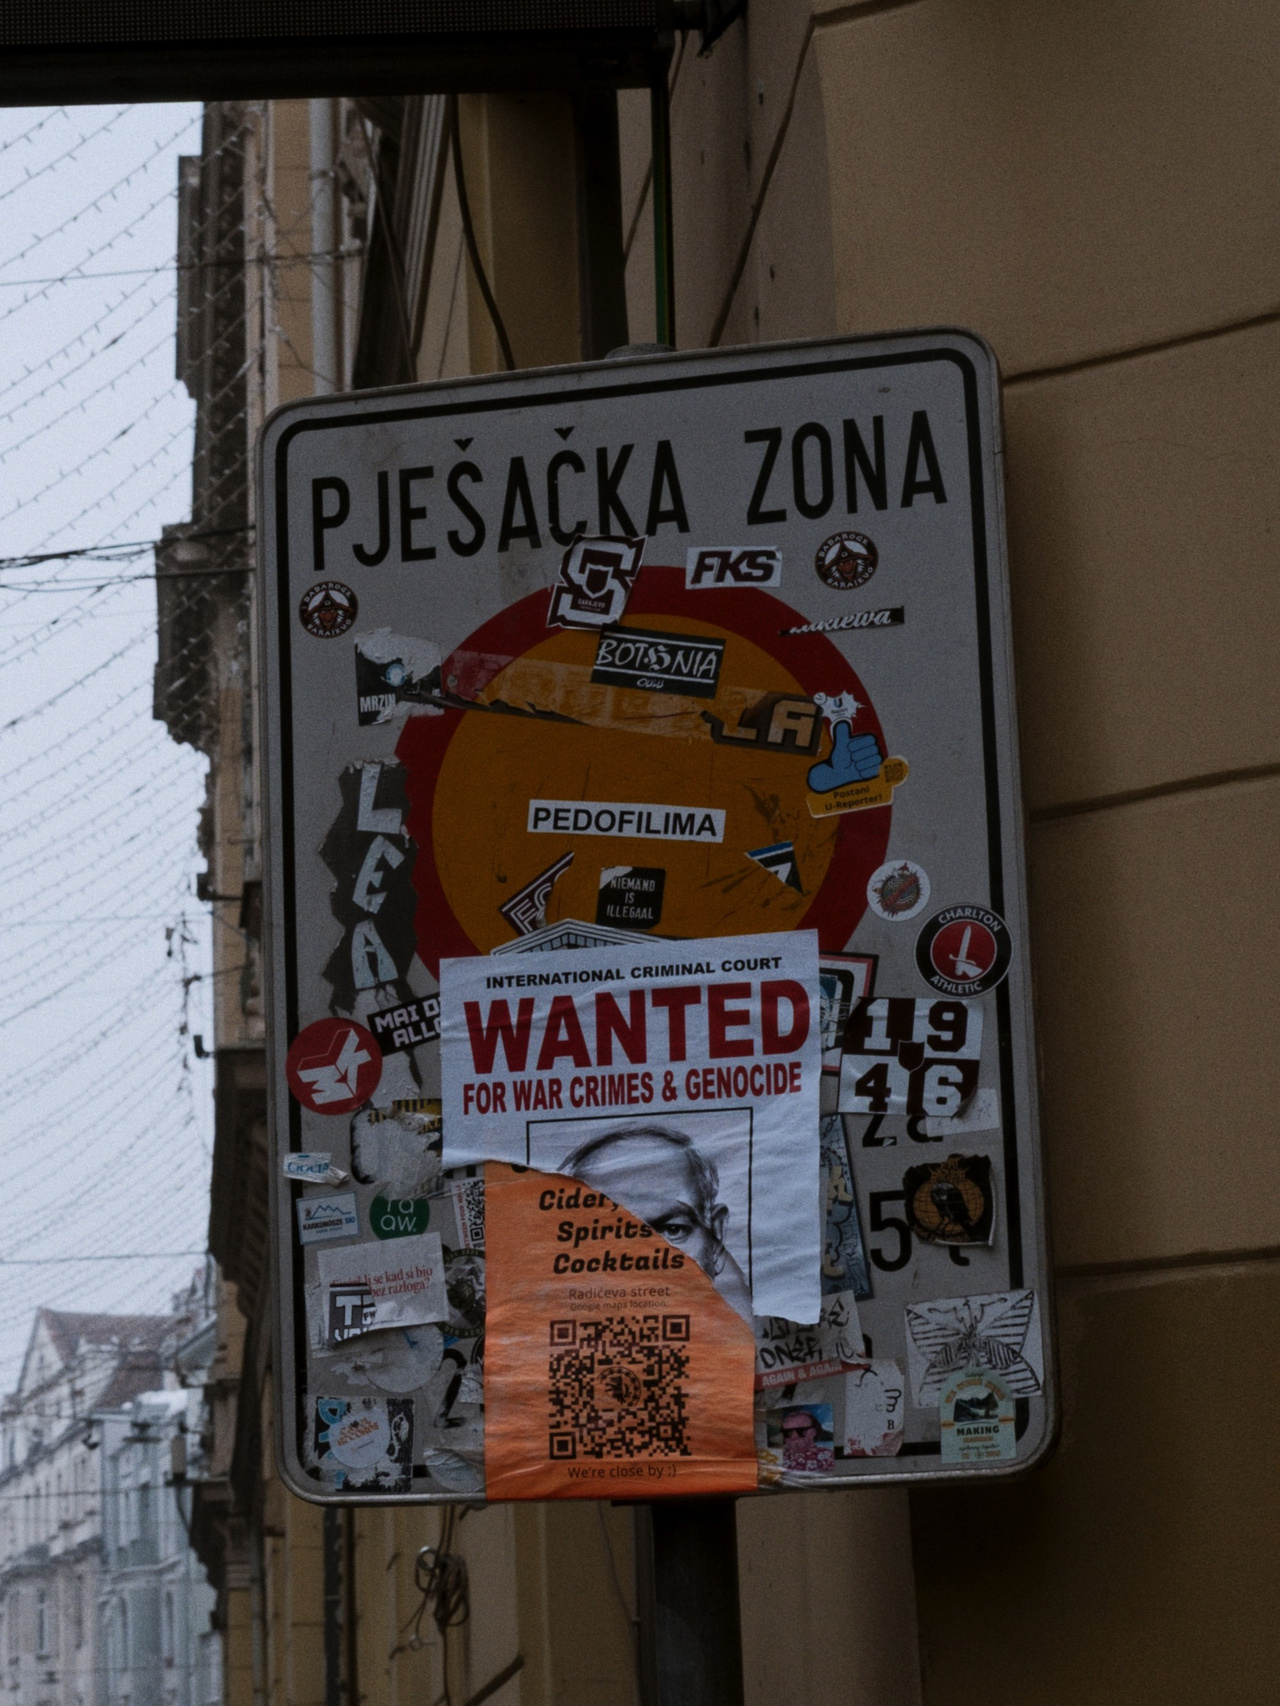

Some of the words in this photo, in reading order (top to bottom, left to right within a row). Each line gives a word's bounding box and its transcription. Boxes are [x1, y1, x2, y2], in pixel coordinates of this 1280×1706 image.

[312, 426, 691, 571] PJEŠAČKA
[744, 410, 948, 526] ZONA
[691, 549, 777, 585] FKS
[824, 794, 883, 811] U-Reporter!
[833, 785, 871, 800] Postani
[532, 807, 718, 837] PEDOFILIMA
[610, 877, 656, 892] NIEMAND
[624, 891, 636, 904] IS
[606, 906, 655, 920] ILLEGAAL
[938, 907, 1003, 933] CHARLTON
[486, 968, 626, 989] INTERNATIONAL
[631, 961, 716, 980] CRIMINAL
[721, 957, 782, 973] COURT
[929, 974, 983, 994] ATHLETIC
[373, 1004, 421, 1034] MAI
[463, 979, 811, 1075] WANTED
[463, 1081, 507, 1116] FOR
[512, 1078, 564, 1112] WAR
[569, 1071, 654, 1109] CRIMES
[661, 1070, 678, 1102] &
[685, 1061, 803, 1102] GENOCIDE
[556, 1218, 653, 1247] Spirits
[553, 1248, 685, 1274] Cocktails
[384, 1268, 405, 1284] kad
[405, 1266, 414, 1280] si
[415, 1264, 433, 1277] bio
[388, 1276, 431, 1296] razloga?
[569, 1285, 627, 1300] Radićeva
[630, 1286, 670, 1298] street
[569, 1300, 601, 1312] Google
[602, 1300, 628, 1310] maps
[761, 1370, 795, 1387] AGAIN
[797, 1367, 807, 1380] &
[956, 1425, 1000, 1436] MAKING
[608, 1465, 644, 1478] close
[647, 1464, 663, 1479] by
